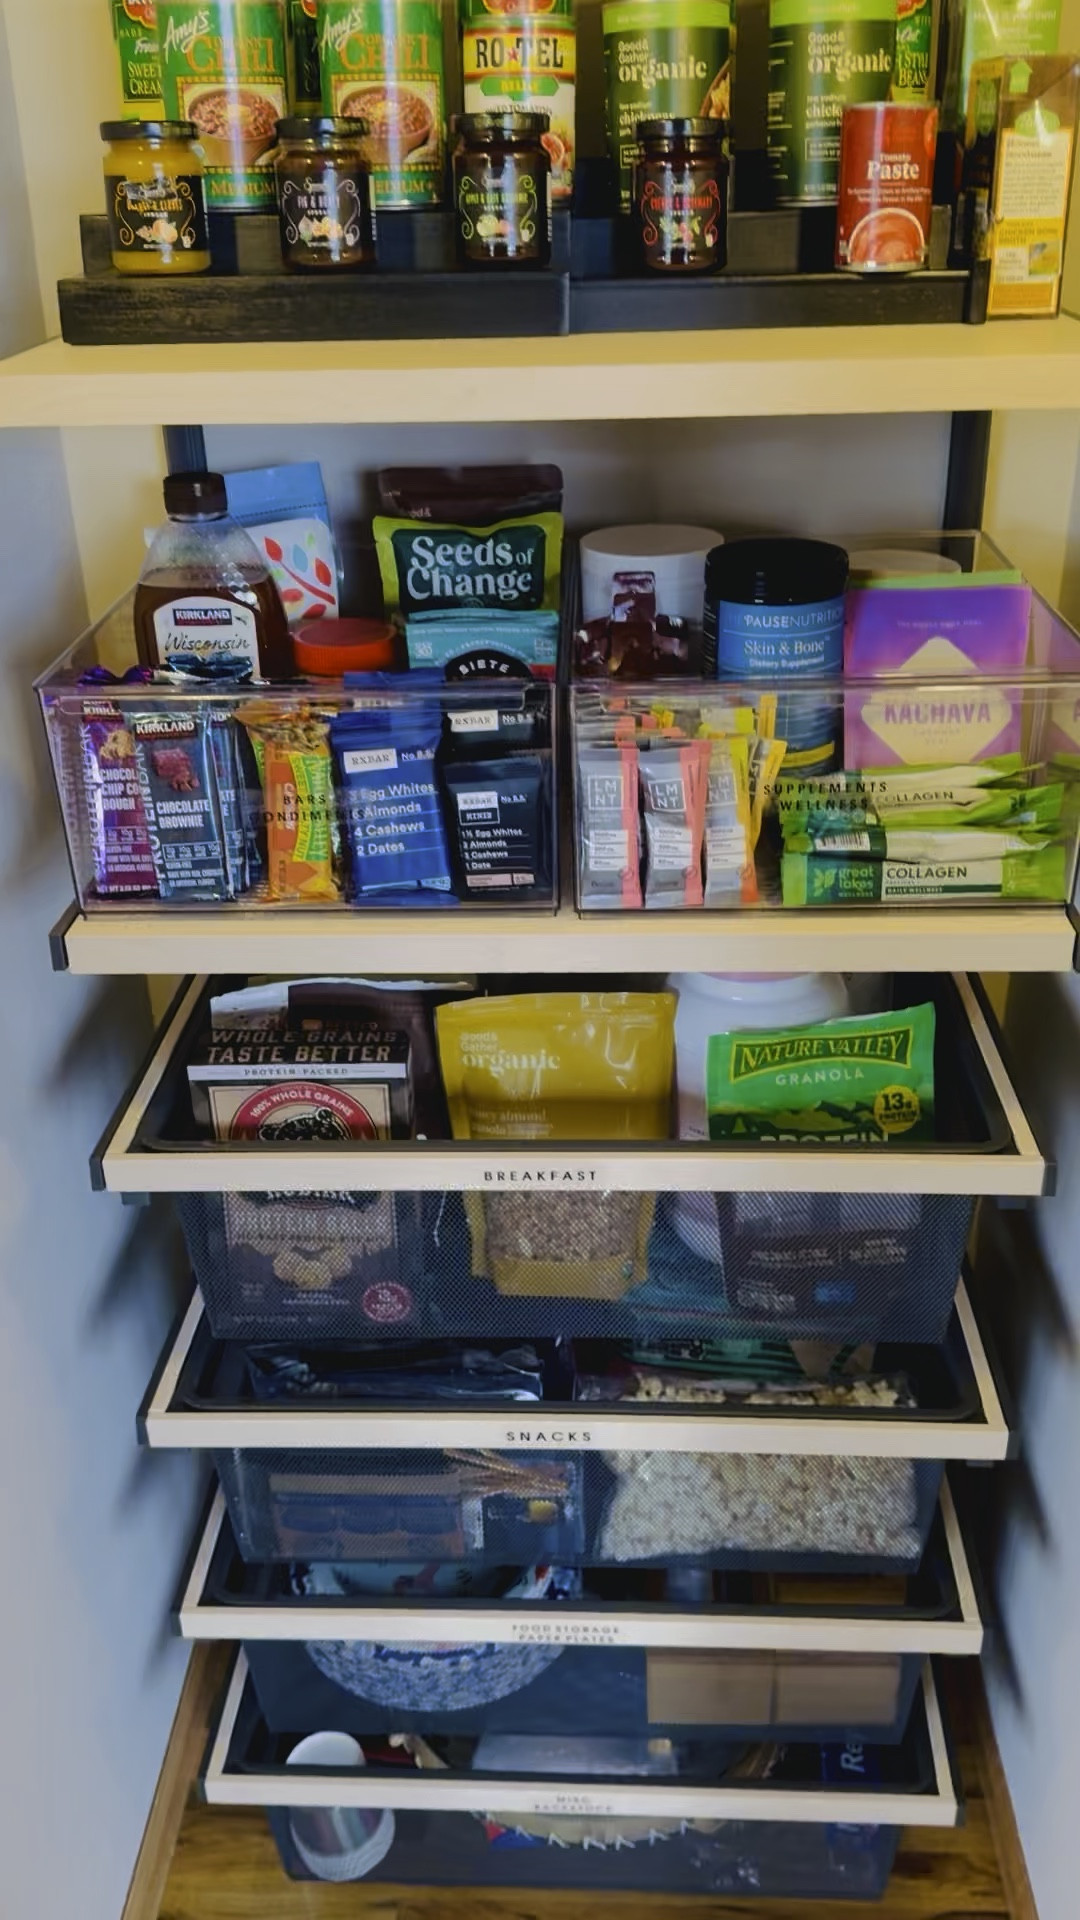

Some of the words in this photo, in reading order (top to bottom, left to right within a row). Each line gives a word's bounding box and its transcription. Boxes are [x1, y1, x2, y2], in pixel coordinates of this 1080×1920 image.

[618, 56, 707, 89] organic
[808, 48, 891, 82] organic
[867, 160, 920, 180] Paste
[211, 181, 274, 196] MEIUM
[411, 535, 513, 569] Seeds
[516, 547, 535, 565] of
[407, 566, 533, 600] Change
[175, 610, 230, 620] KIRKLAND
[165, 631, 250, 652] Wisconsin
[744, 640, 775, 655] Skin
[779, 640, 790, 656] &
[794, 640, 825, 653] Bone
[459, 659, 511, 676] SIETE
[135, 720, 196, 736] KIRKLAND
[455, 715, 493, 726] RXBAR
[351, 754, 391, 766] RXBAR
[388, 782, 435, 795] Whites
[763, 781, 889, 796] SUPPLEMENTS
[156, 799, 211, 814] CHOCOLATE
[283, 794, 327, 805] BARS
[780, 798, 869, 812] WELLNESS
[363, 802, 422, 817] Almonds
[158, 815, 205, 828] BROWNIE
[366, 820, 425, 837] Cashews
[493, 828, 523, 837] Whites
[367, 841, 405, 855] Dates
[470, 839, 508, 849] Almonds
[472, 861, 492, 870] Date
[838, 866, 874, 879] great
[887, 866, 967, 879] COLLAGEN
[838, 876, 874, 891] lakes
[211, 1031, 298, 1044] WHOLE
[307, 1031, 397, 1044] GRAINS
[207, 1045, 285, 1063] TASTE
[294, 1045, 391, 1062] BETTER
[739, 1039, 824, 1074] NATURE
[828, 1032, 905, 1060] VALLEY
[461, 1048, 561, 1079] organic
[243, 1068, 297, 1076] PROTEIN
[302, 1067, 349, 1076] PACKED
[775, 1067, 865, 1086] GRANOLA
[270, 1089, 312, 1104] WHOLE
[314, 1092, 355, 1117] GRAINS
[484, 1170, 598, 1182] BREAKFAST
[506, 1431, 592, 1442] SNACKS
[512, 1624, 551, 1633] FOOD
[555, 1625, 620, 1635] STORAGE
